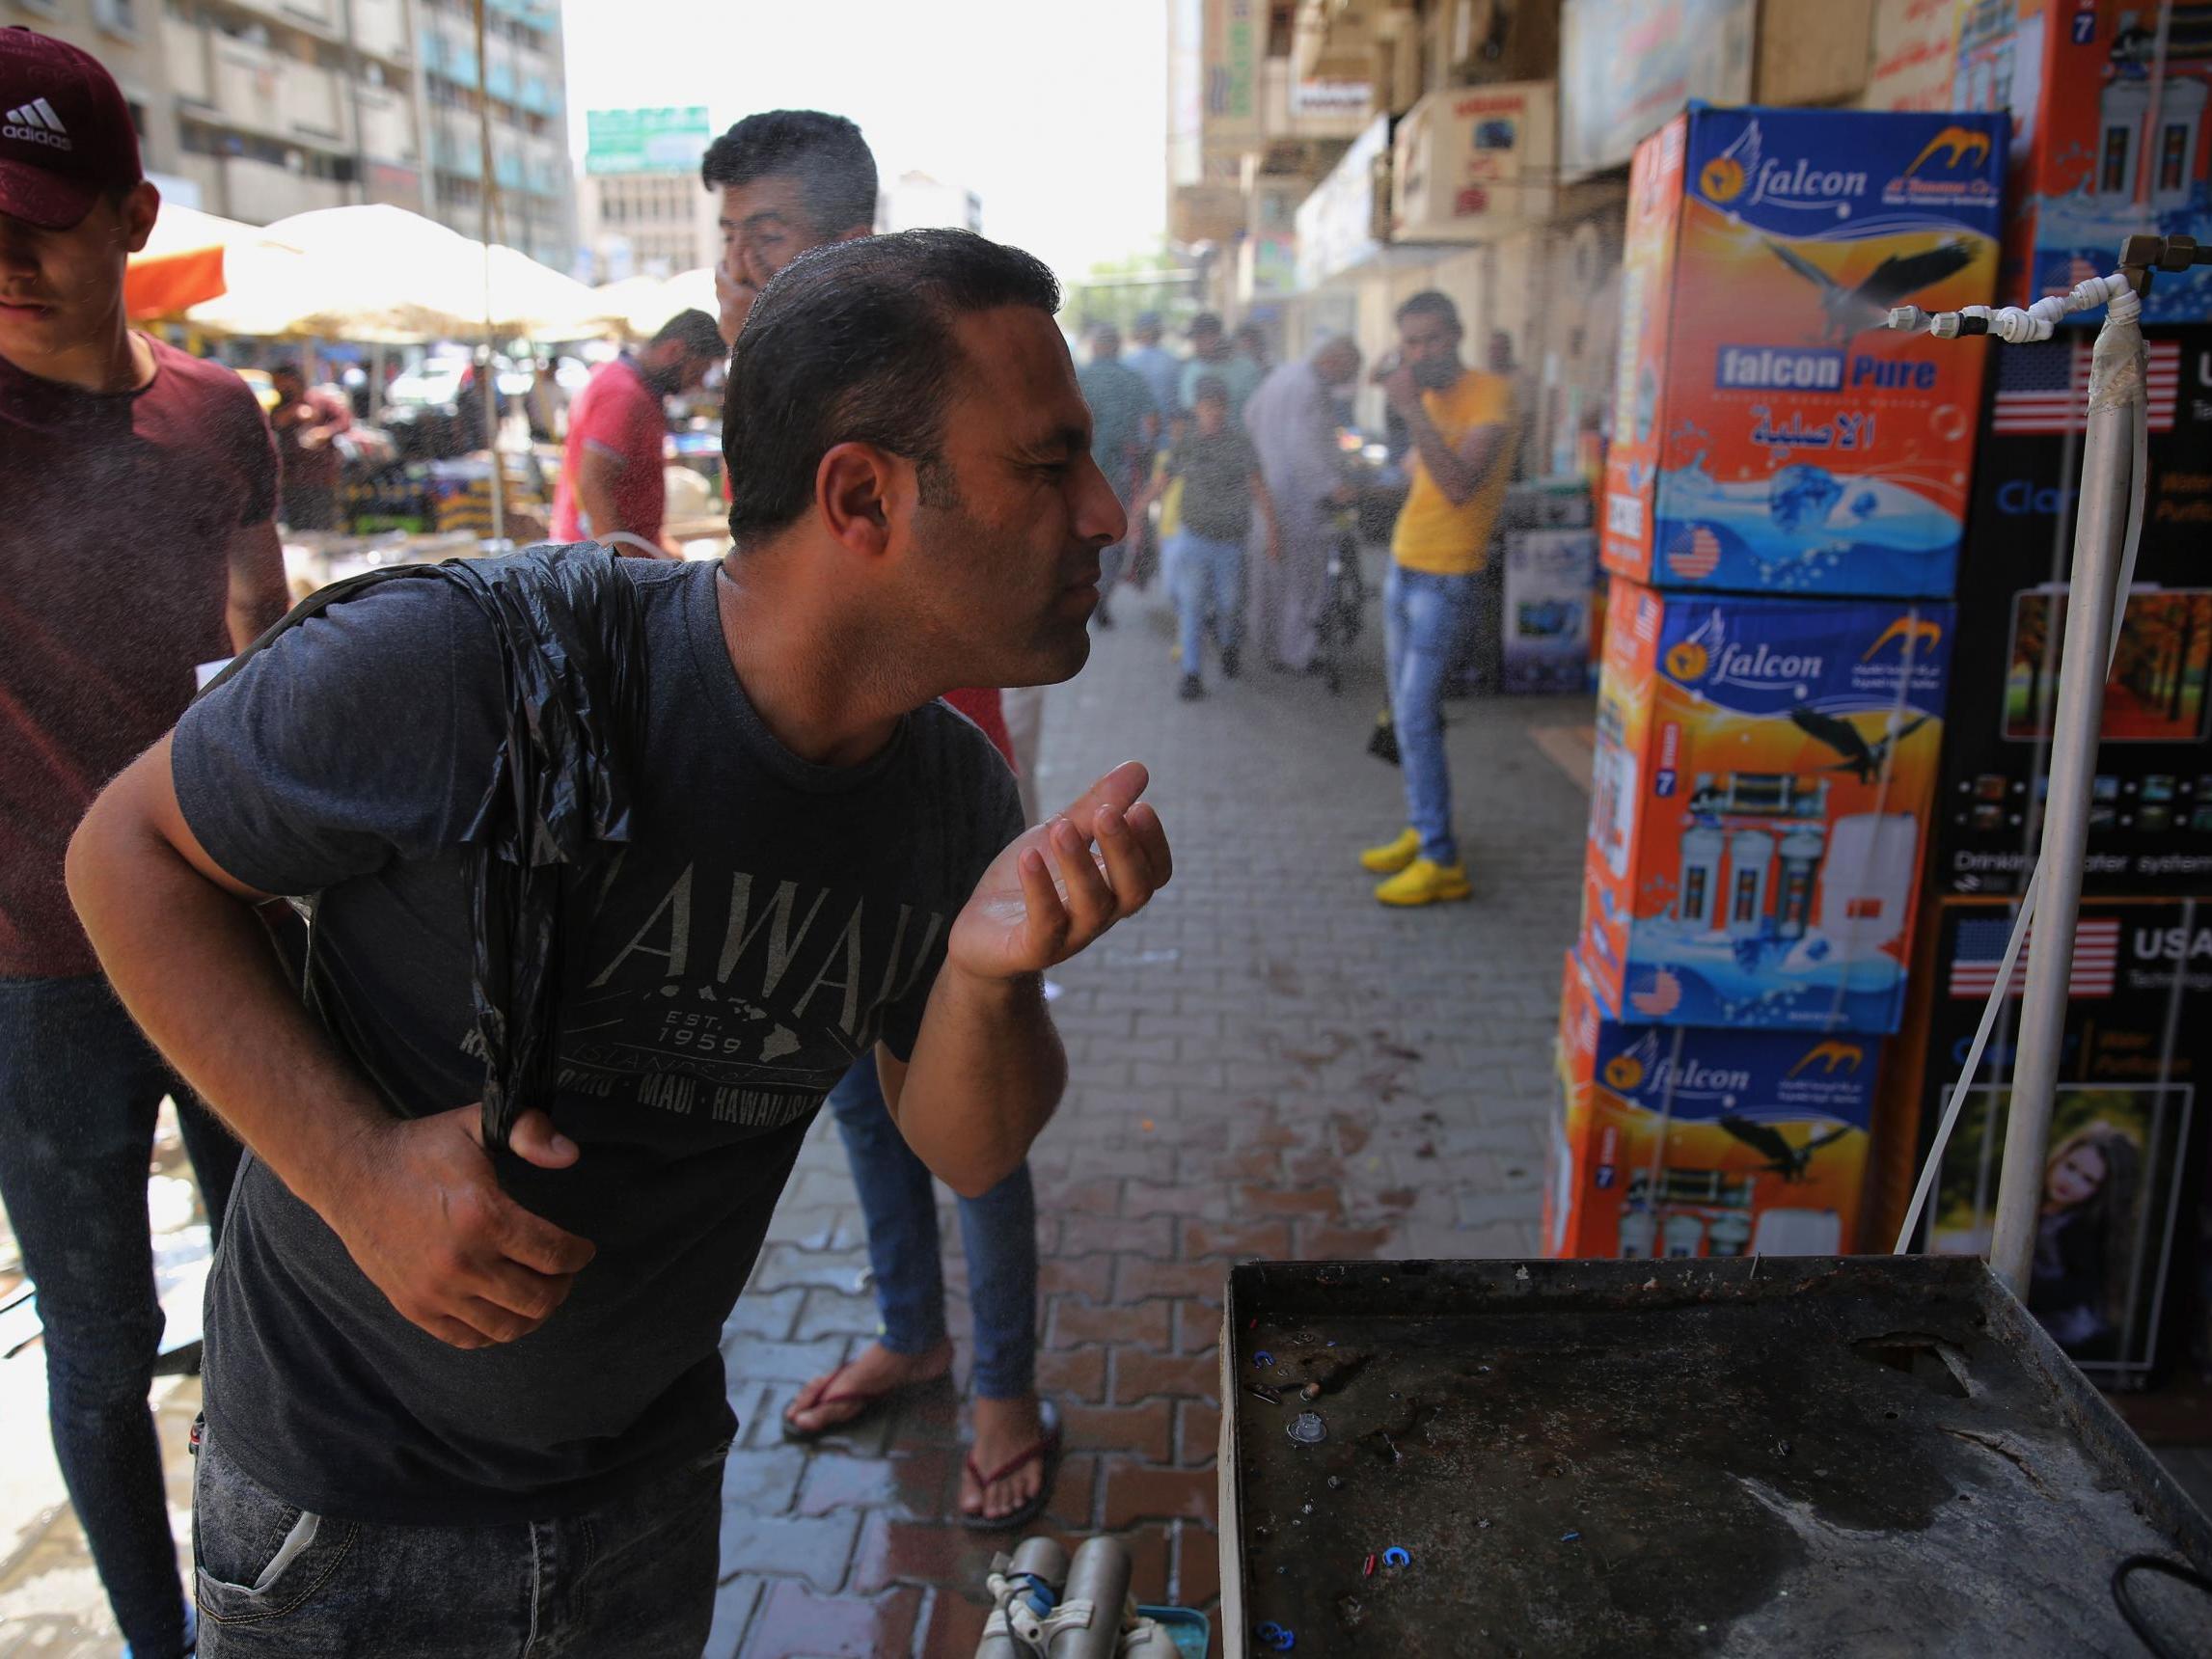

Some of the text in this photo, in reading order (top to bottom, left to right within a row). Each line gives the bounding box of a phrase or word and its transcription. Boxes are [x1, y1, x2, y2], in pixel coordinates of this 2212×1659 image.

[2074, 14, 2093, 43] 7
[4, 125, 72, 150] adidas
[1748, 156, 1869, 204] falcon
[1722, 348, 1937, 390] falcon Pure
[1749, 403, 1877, 458] الاصلية
[1710, 642, 1823, 684] falcon
[1656, 772, 1674, 796] 7
[1953, 850, 2039, 874] Drinkin
[2133, 926, 2212, 960] USA
[665, 1010, 724, 1031] EST.
[657, 1026, 742, 1054] 1959
[637, 1073, 696, 1115] MAUI
[1648, 1058, 1749, 1096] falcon
